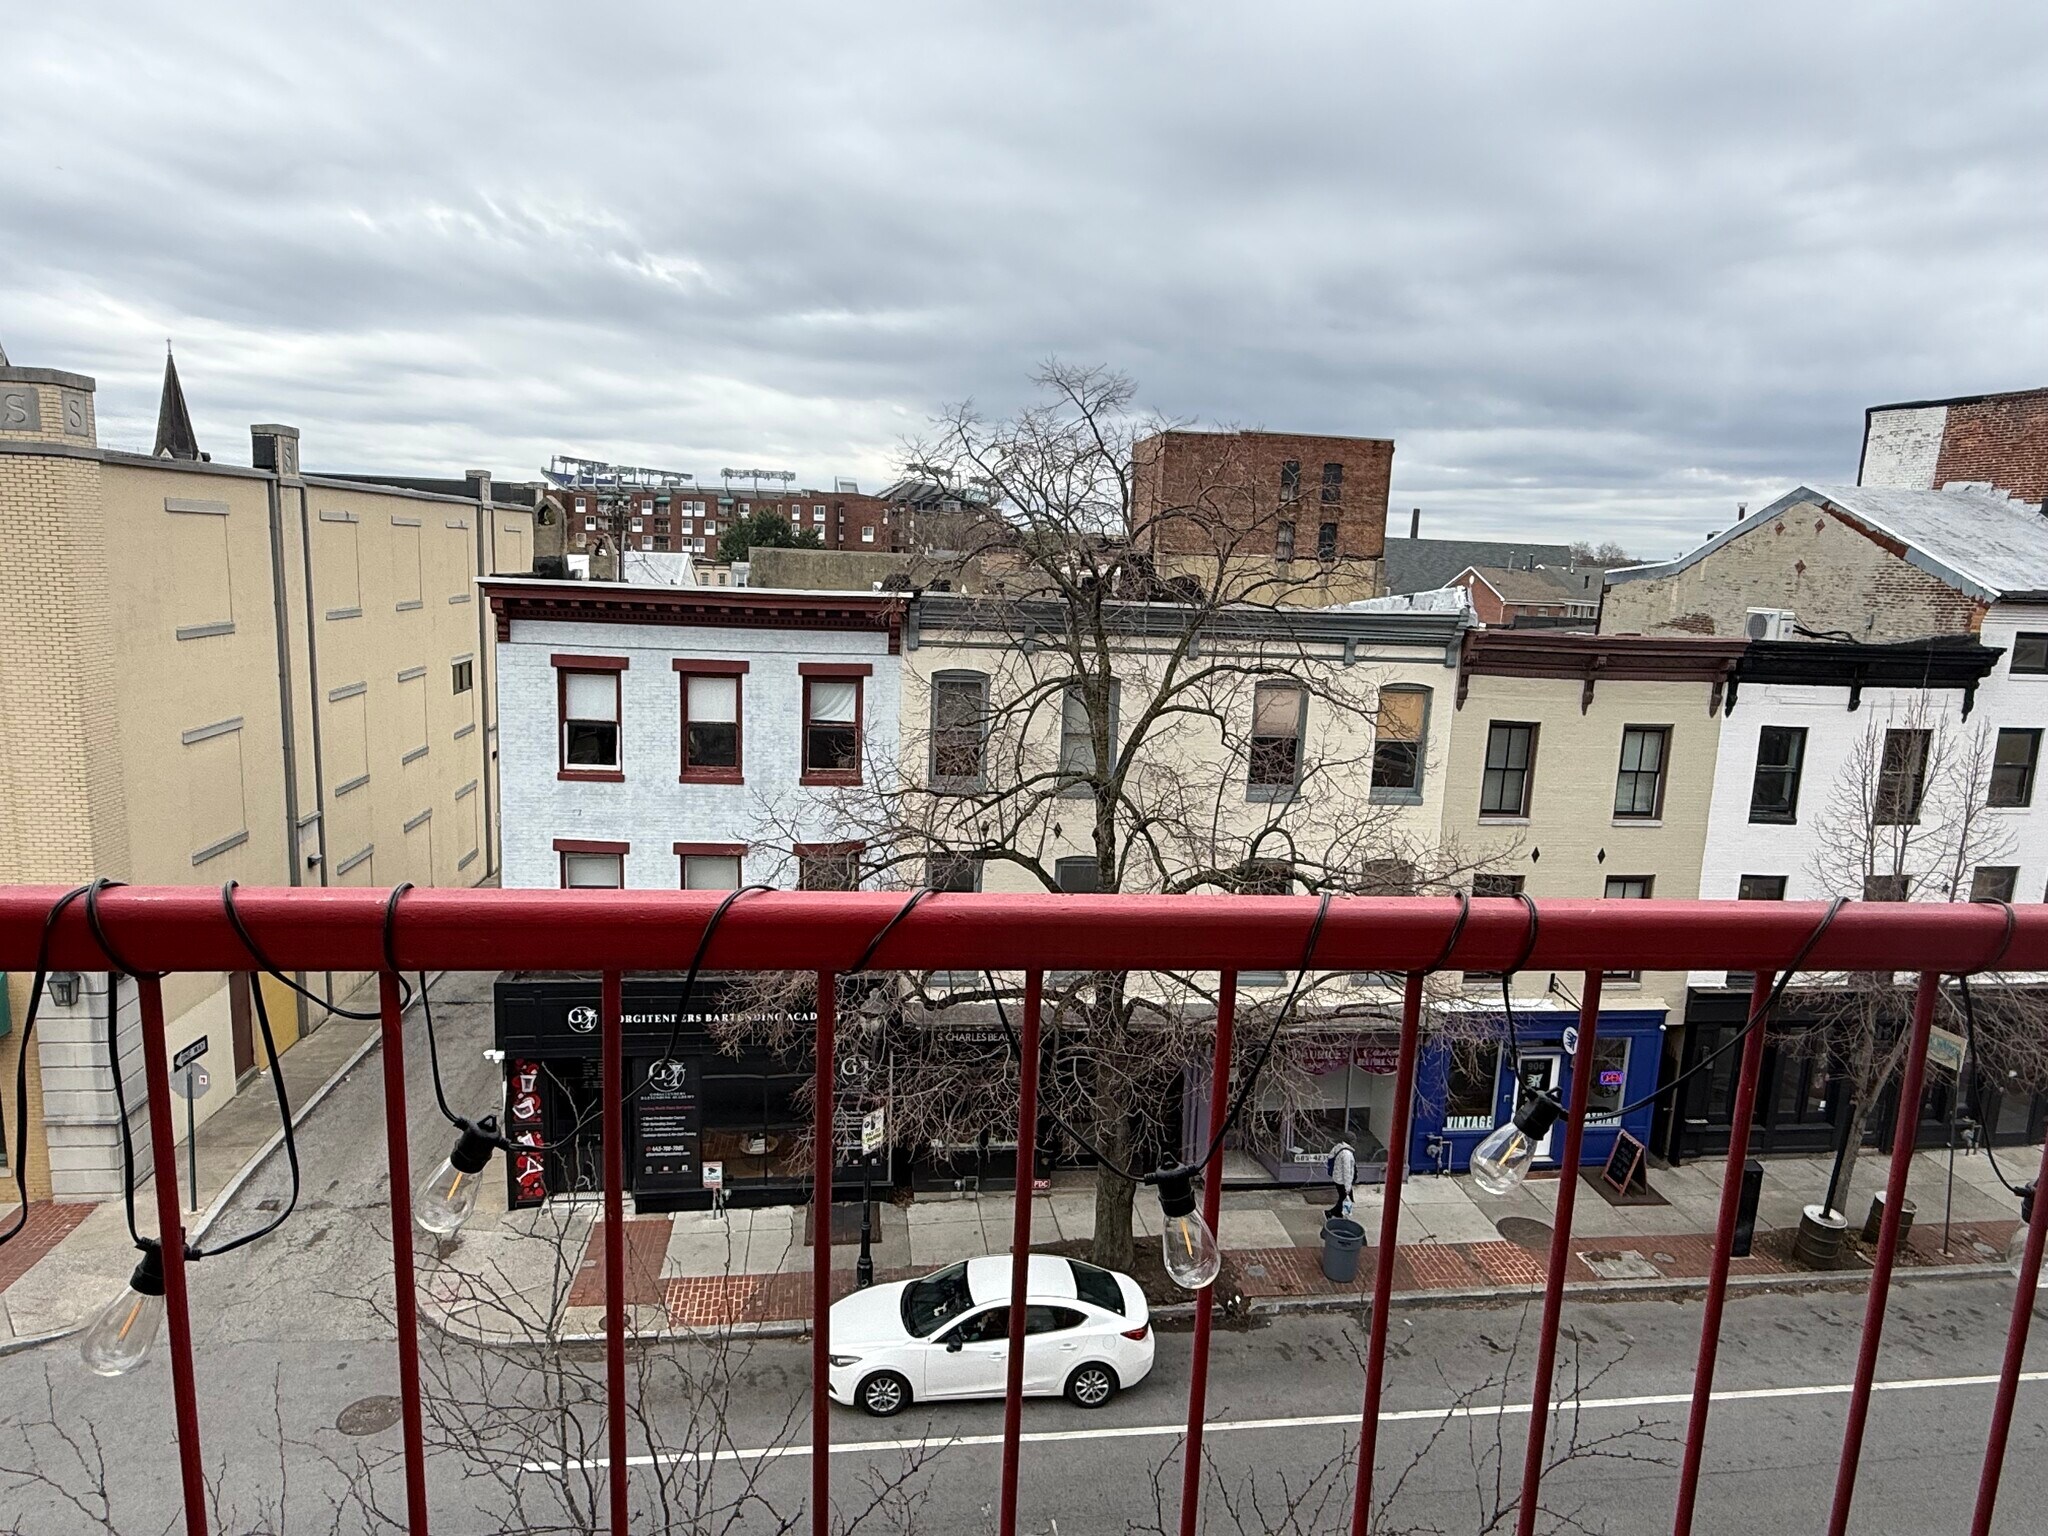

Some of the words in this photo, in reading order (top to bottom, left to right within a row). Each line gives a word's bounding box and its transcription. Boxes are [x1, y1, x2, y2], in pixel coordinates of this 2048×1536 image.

[4, 393, 28, 424] S
[69, 400, 83, 428] S
[620, 1013, 702, 1024] RGITENERS
[946, 1032, 987, 1042] CHARLES
[1527, 1061, 1546, 1071] 906
[1446, 1115, 1493, 1129] VINTAGE
